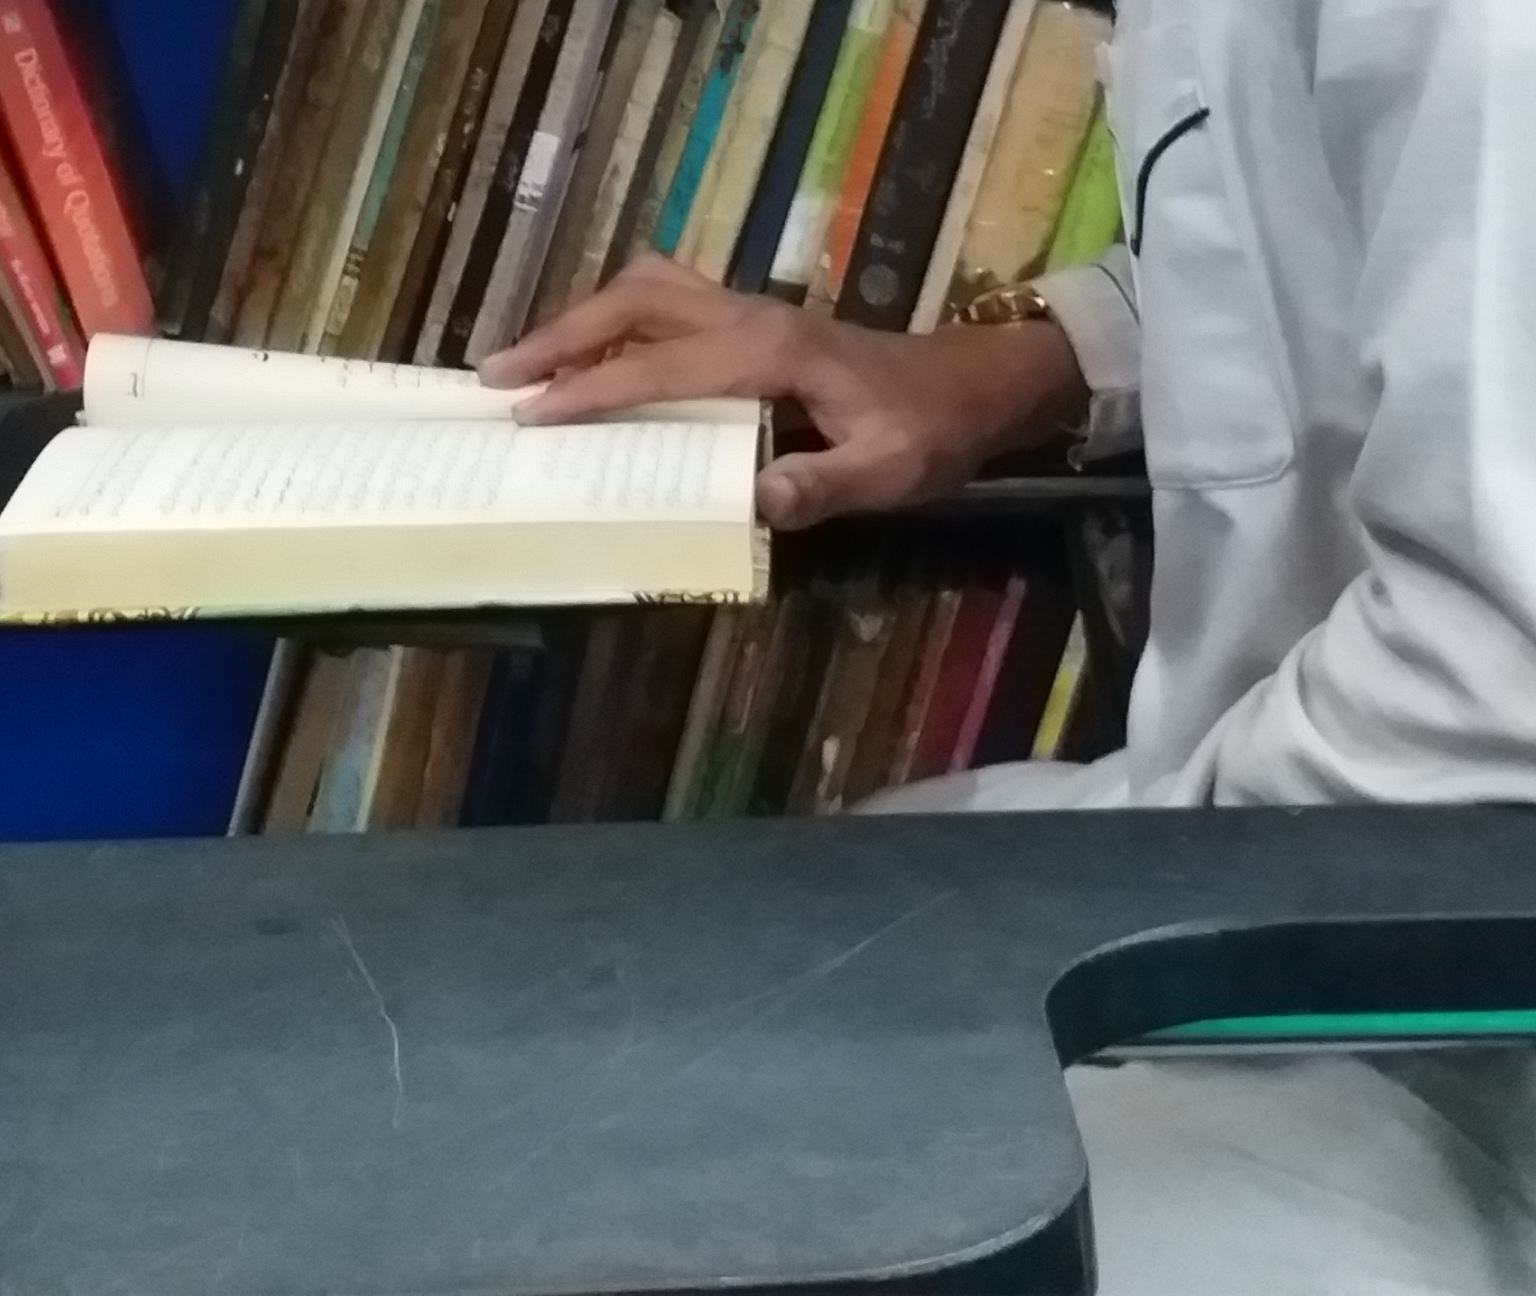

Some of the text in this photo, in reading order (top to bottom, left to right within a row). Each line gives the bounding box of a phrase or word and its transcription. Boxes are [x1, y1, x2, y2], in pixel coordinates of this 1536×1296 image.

[12, 48, 124, 309] Dictionary of Quotations
